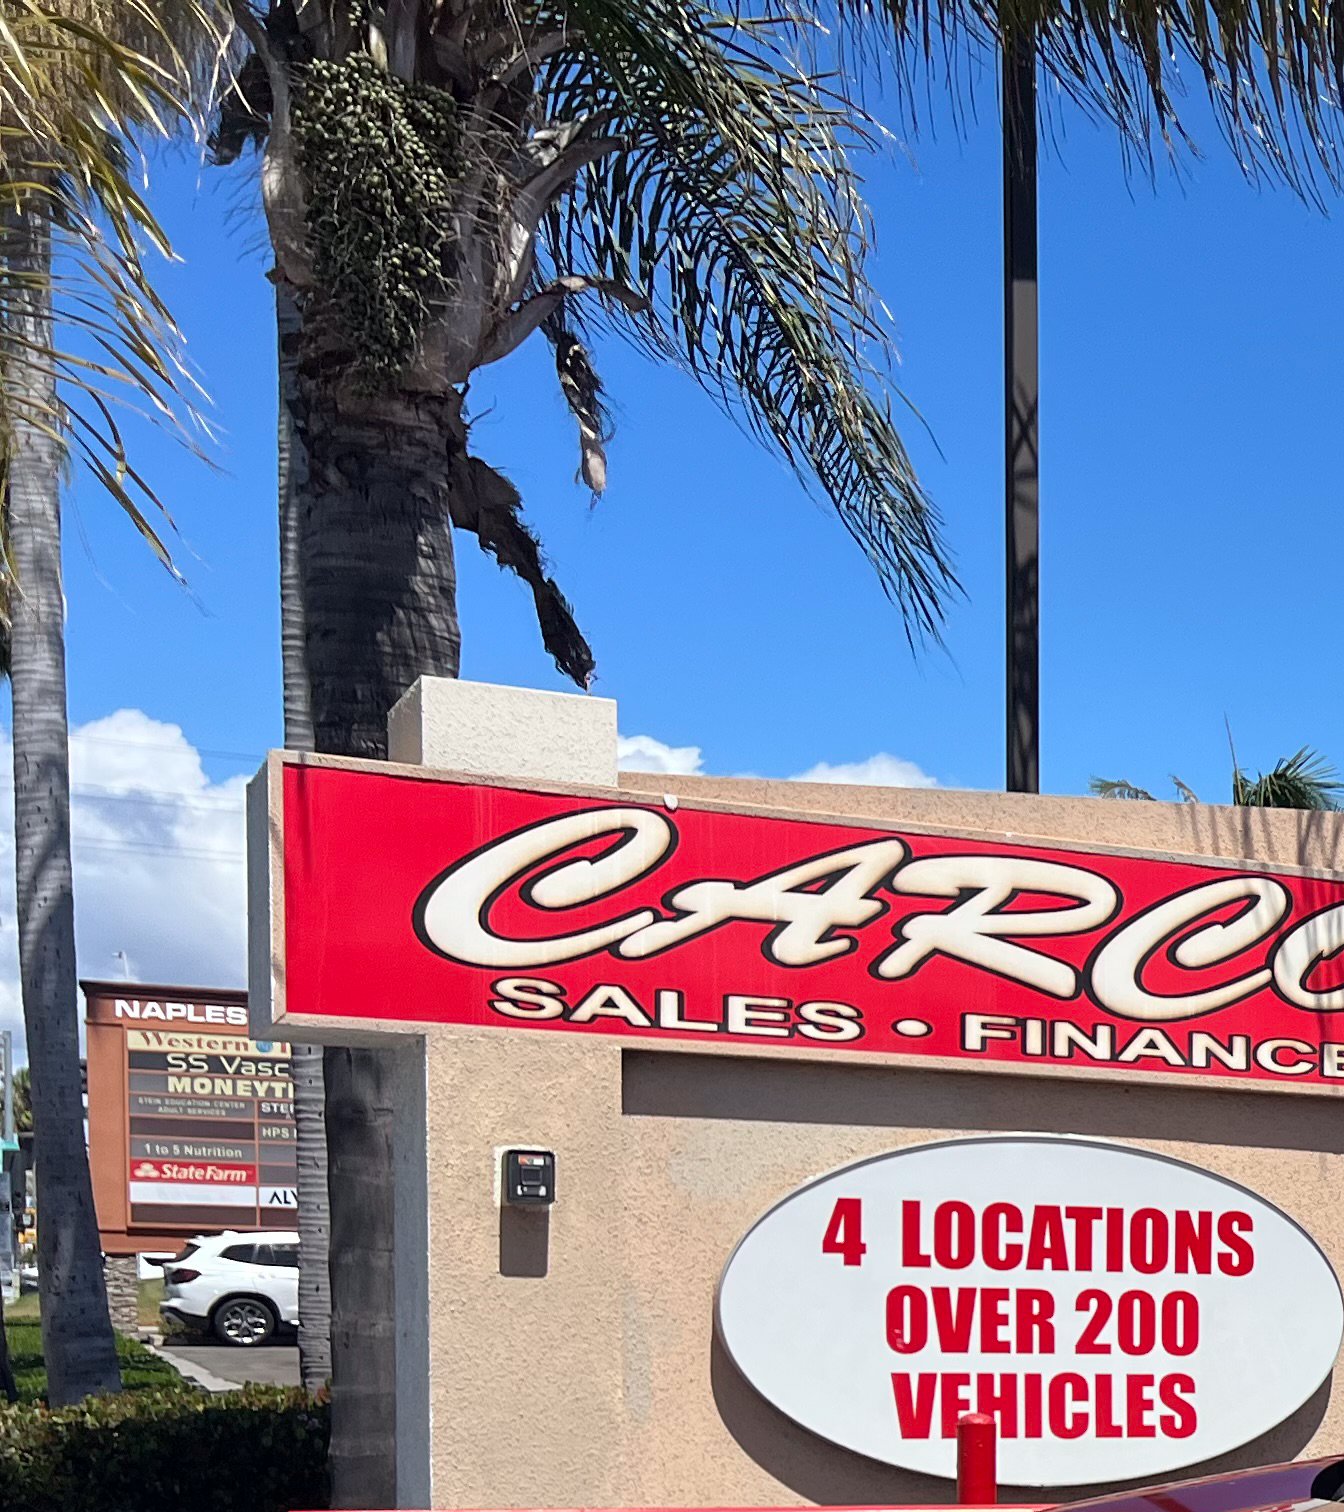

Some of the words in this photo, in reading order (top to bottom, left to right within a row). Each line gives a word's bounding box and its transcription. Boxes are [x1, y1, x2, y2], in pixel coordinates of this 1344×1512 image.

[115, 999, 248, 1025] NAPLES
[489, 977, 865, 1042] SALES
[141, 1032, 249, 1052] Western
[167, 1053, 209, 1073] SS
[155, 1144, 169, 1155] to
[184, 1144, 243, 1158] Nutrition
[822, 1197, 867, 1267] 4
[901, 1199, 1255, 1277] LOCATIONS
[885, 1284, 1056, 1355] OVER
[1074, 1288, 1200, 1357] 200
[890, 1371, 1199, 1441] VEHICLES
